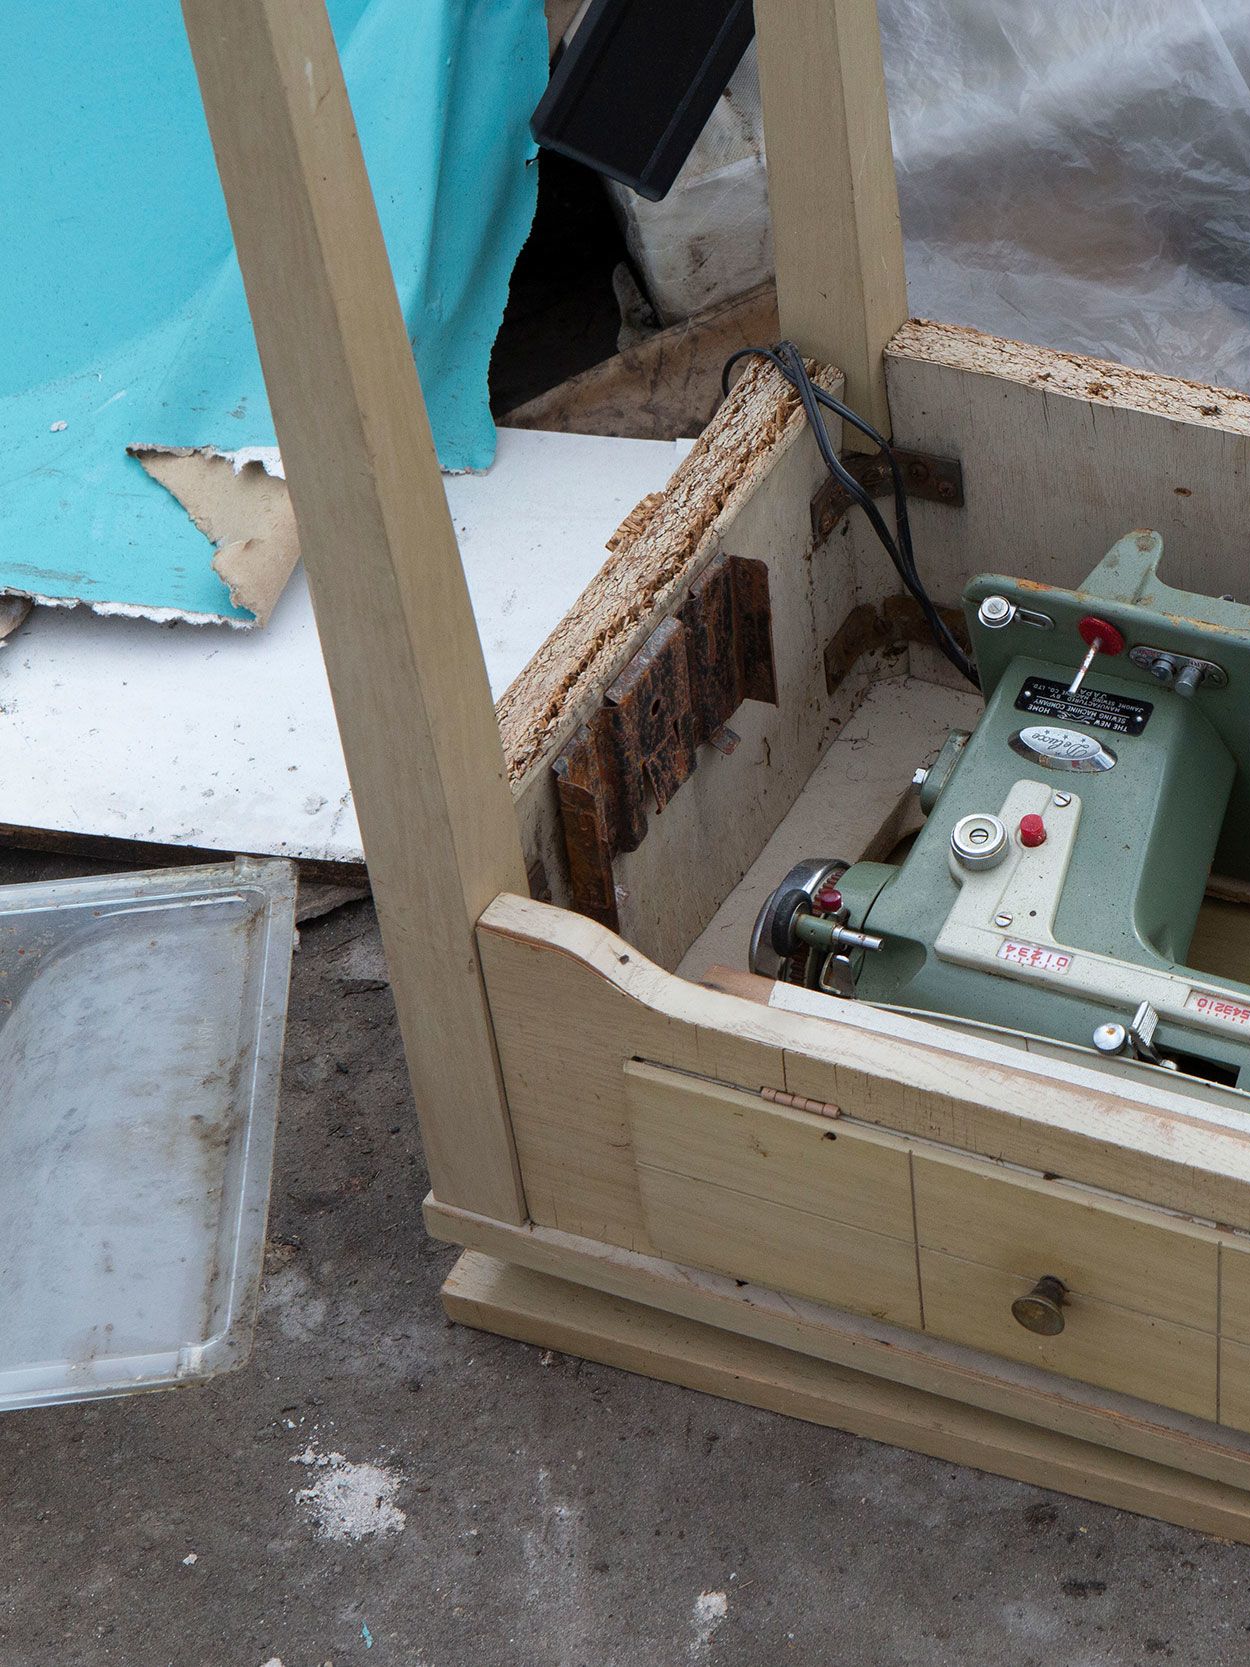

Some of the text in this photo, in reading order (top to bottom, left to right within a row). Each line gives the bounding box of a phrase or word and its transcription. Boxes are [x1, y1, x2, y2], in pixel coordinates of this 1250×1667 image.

[1079, 688, 1108, 699] JAPA
[1091, 696, 1116, 706] SEWING
[1049, 692, 1121, 713] MANUFACTURED BY
[1117, 702, 1145, 713] JANOME
[1027, 703, 1128, 732] THE NEW HOME
[1032, 698, 1127, 724] SEWING MACHINE COMPANY
